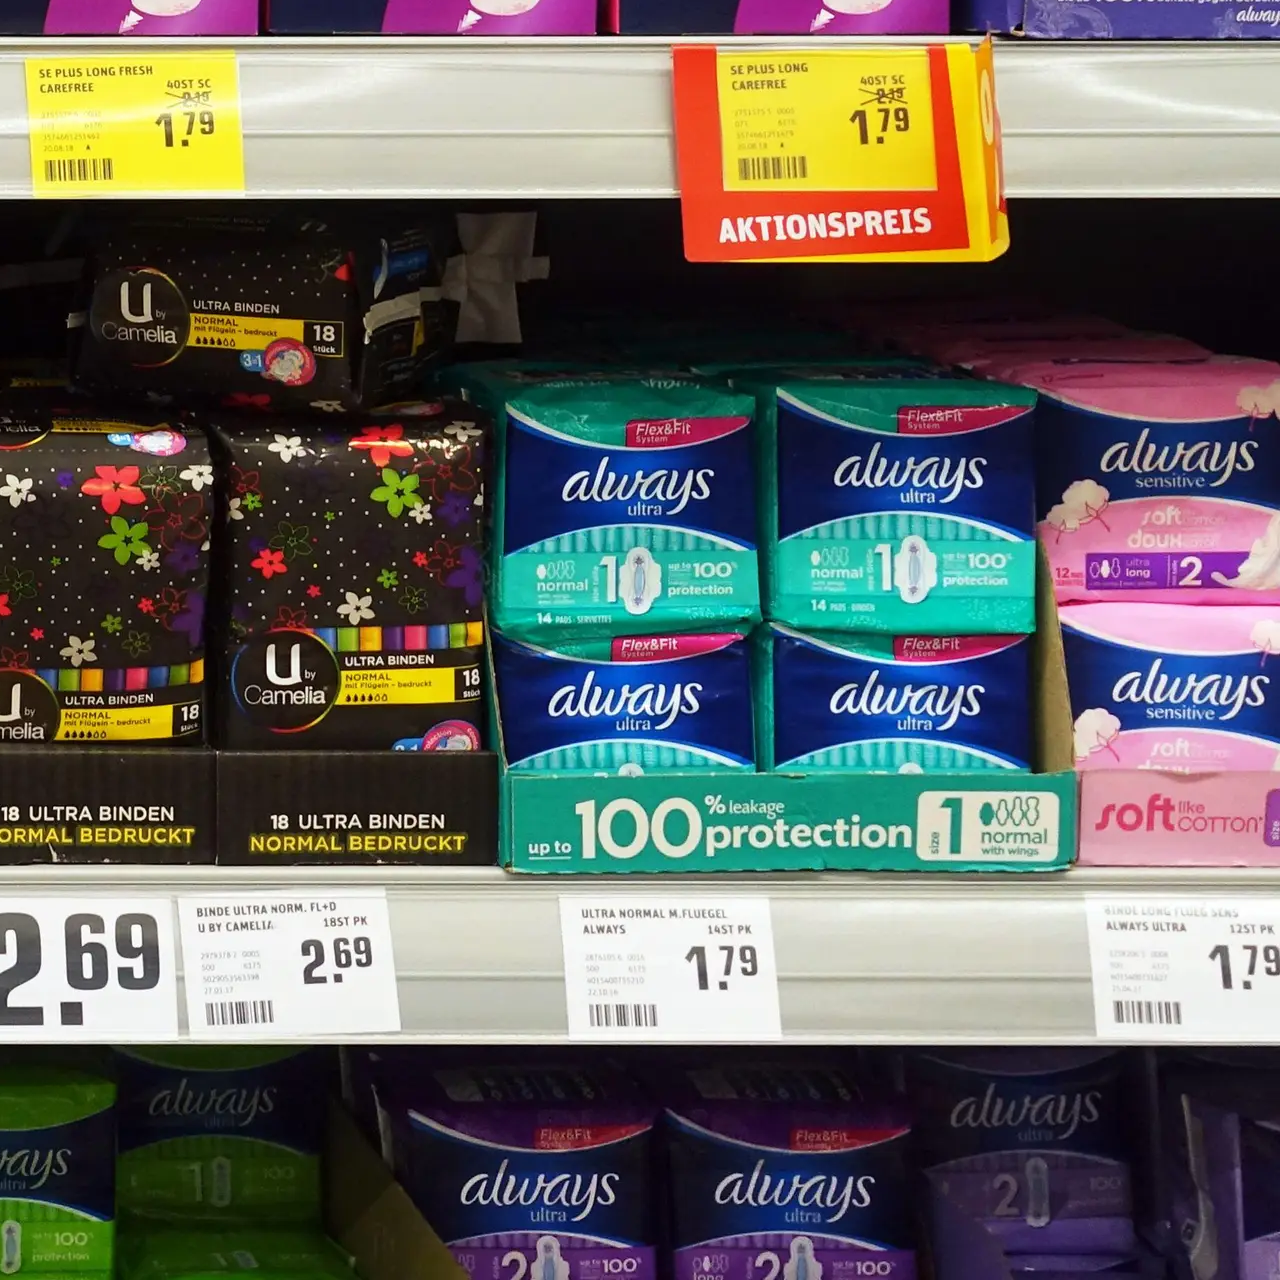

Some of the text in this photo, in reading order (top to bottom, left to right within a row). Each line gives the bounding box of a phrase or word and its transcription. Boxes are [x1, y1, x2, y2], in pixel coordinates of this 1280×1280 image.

[849, 109, 910, 146] 1.79
[719, 208, 931, 244] AKTIONSPREIS
[548, 669, 702, 731] always
[1, 804, 174, 822] 18 ULTRA BINDEN
[576, 798, 785, 859] 100 leakage
[706, 814, 912, 857] protection
[684, 944, 758, 991] 1.79
[460, 1161, 620, 1224] always
